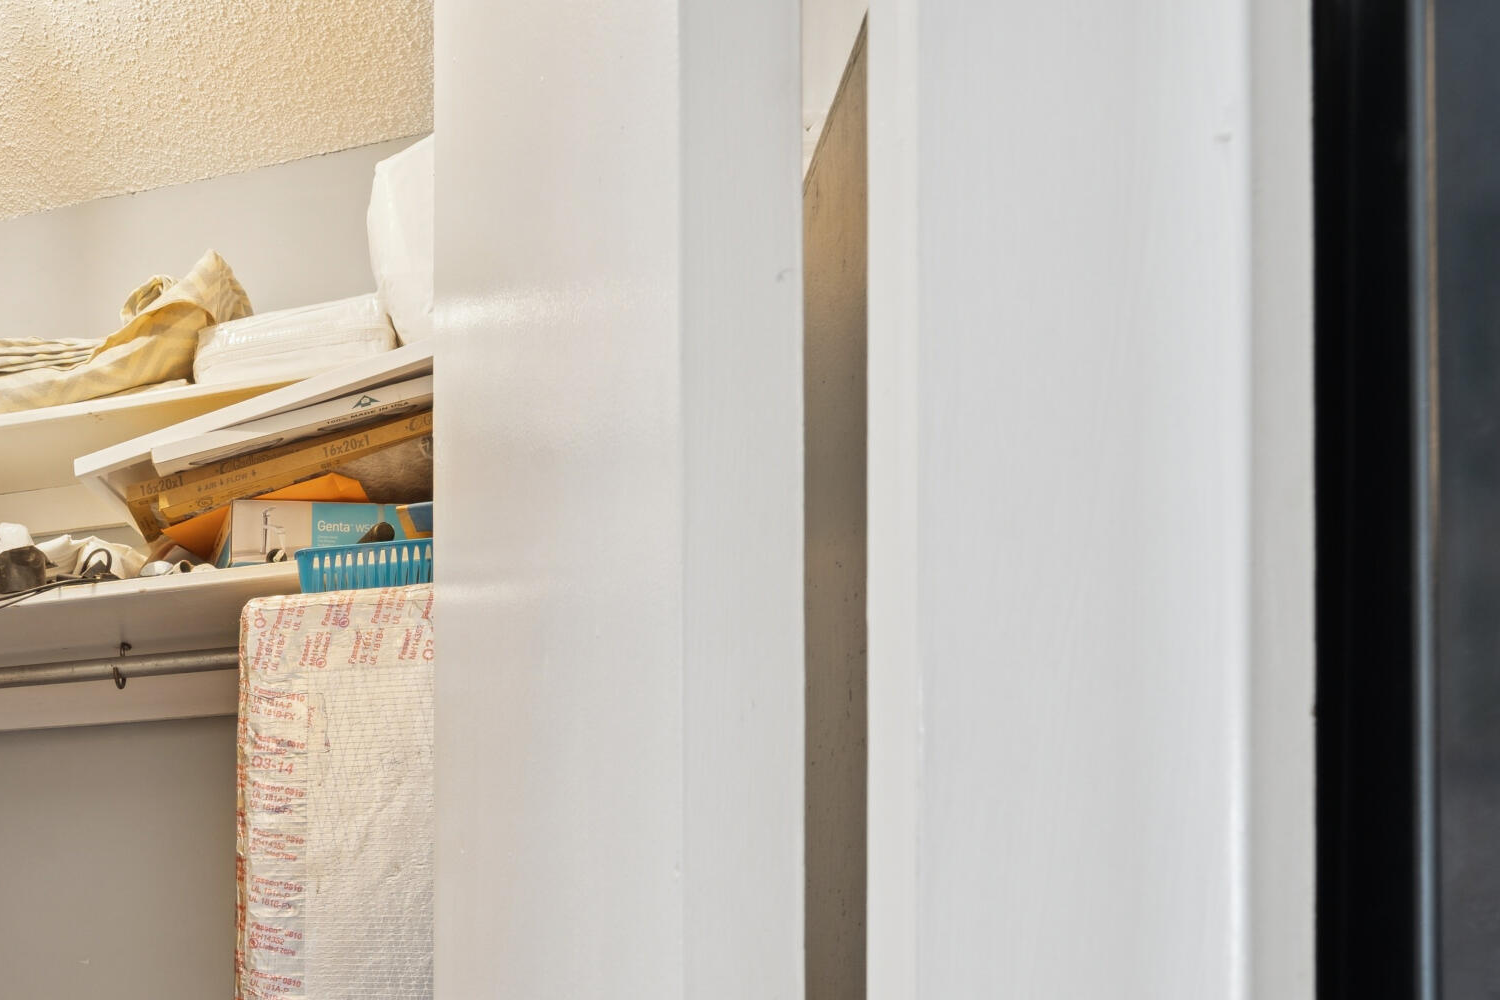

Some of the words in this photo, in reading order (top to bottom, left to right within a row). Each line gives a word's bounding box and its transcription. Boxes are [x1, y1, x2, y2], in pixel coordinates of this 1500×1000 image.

[350, 409, 376, 419] MADE
[322, 434, 370, 458] 16x20x1
[140, 475, 184, 497] 16x20x1
[317, 519, 350, 533] Genta
